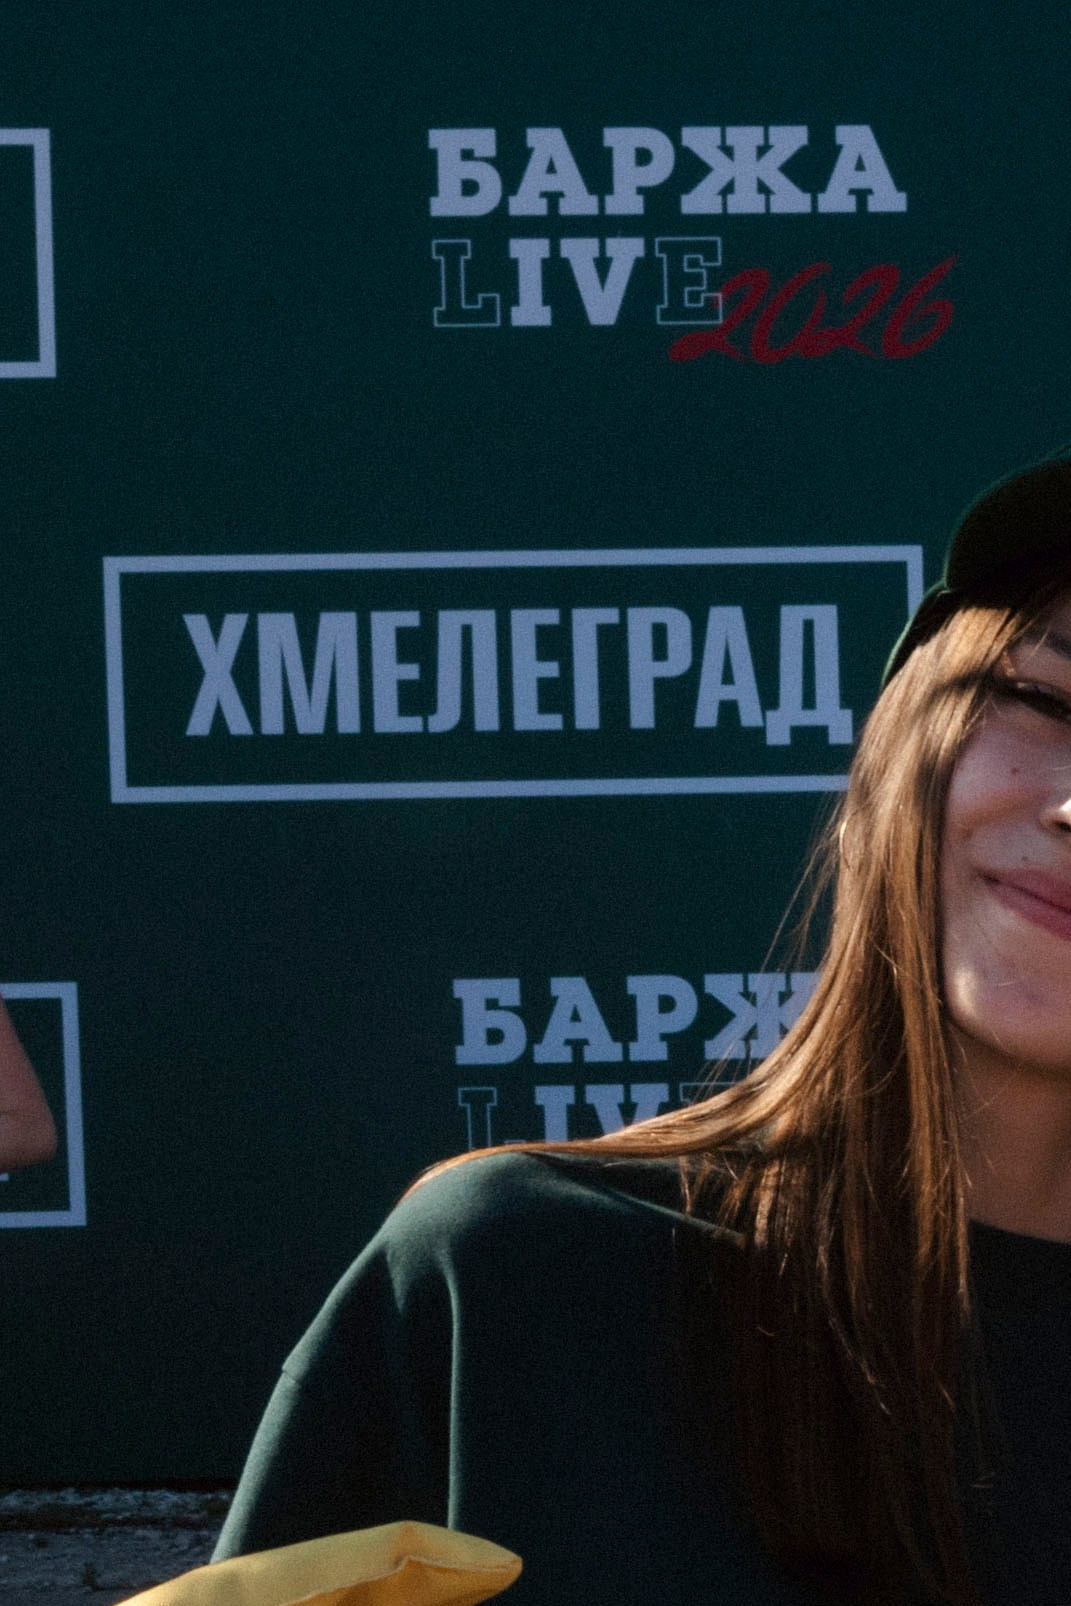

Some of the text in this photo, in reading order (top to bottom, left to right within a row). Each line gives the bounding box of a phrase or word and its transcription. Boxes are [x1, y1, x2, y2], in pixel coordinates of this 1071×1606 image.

[428, 125, 908, 218] БАРЖА
[431, 237, 725, 329] LIVE
[668, 255, 957, 364] 2026
[183, 603, 855, 746] ХМЕЛЕГРАД
[457, 1082, 742, 1151] LIV
